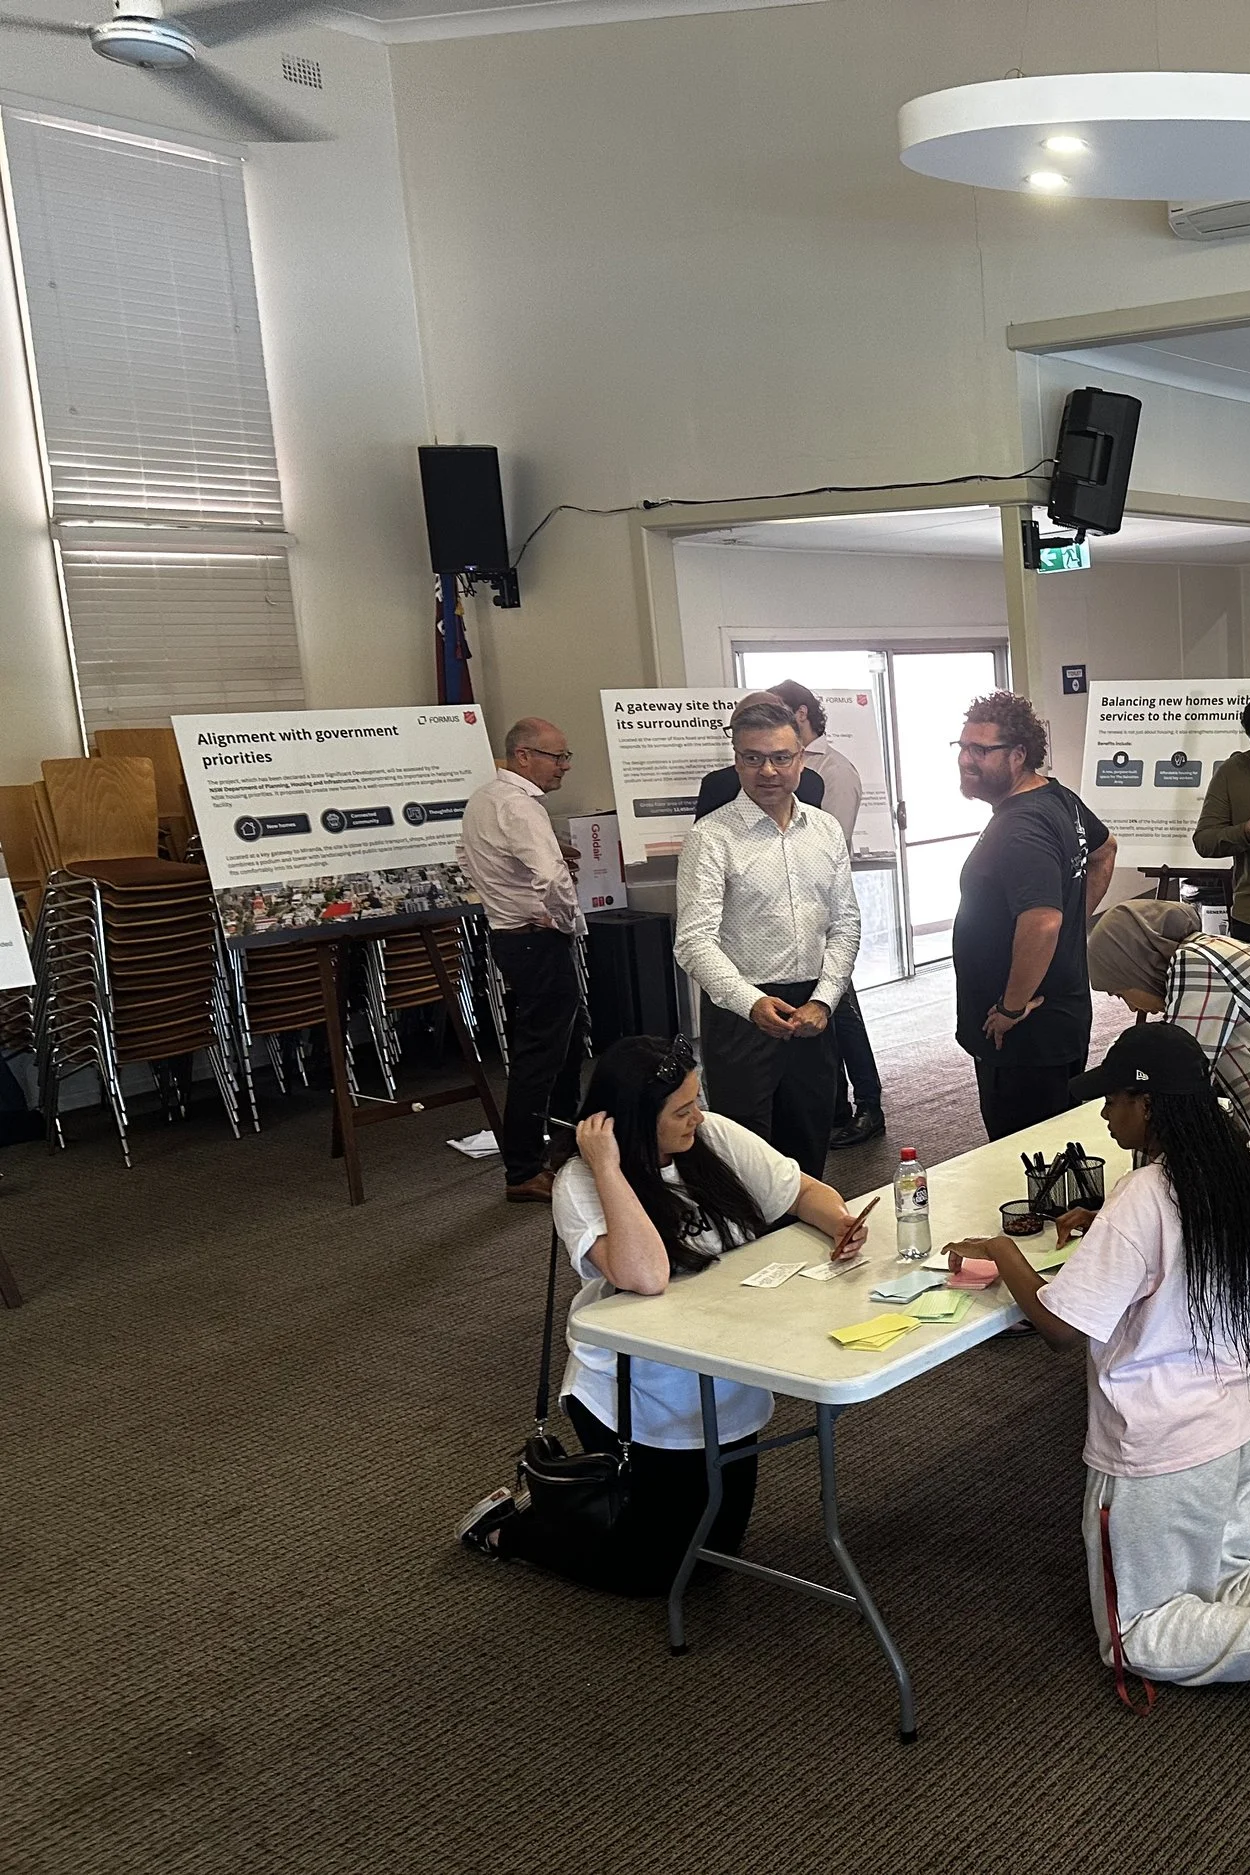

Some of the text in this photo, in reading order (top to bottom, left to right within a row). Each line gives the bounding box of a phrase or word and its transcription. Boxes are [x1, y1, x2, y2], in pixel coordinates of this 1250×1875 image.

[614, 699, 737, 714] A gateway site that
[1101, 696, 1156, 708] Balancing
[1159, 698, 1182, 706] new
[1185, 696, 1223, 706] homes
[429, 716, 459, 724] FORMUS
[1100, 711, 1243, 721] services to the communit
[617, 717, 723, 731] its surroundings
[197, 726, 399, 747] Alignment with government
[202, 751, 272, 769] priorities
[591, 823, 601, 861] Goldair
